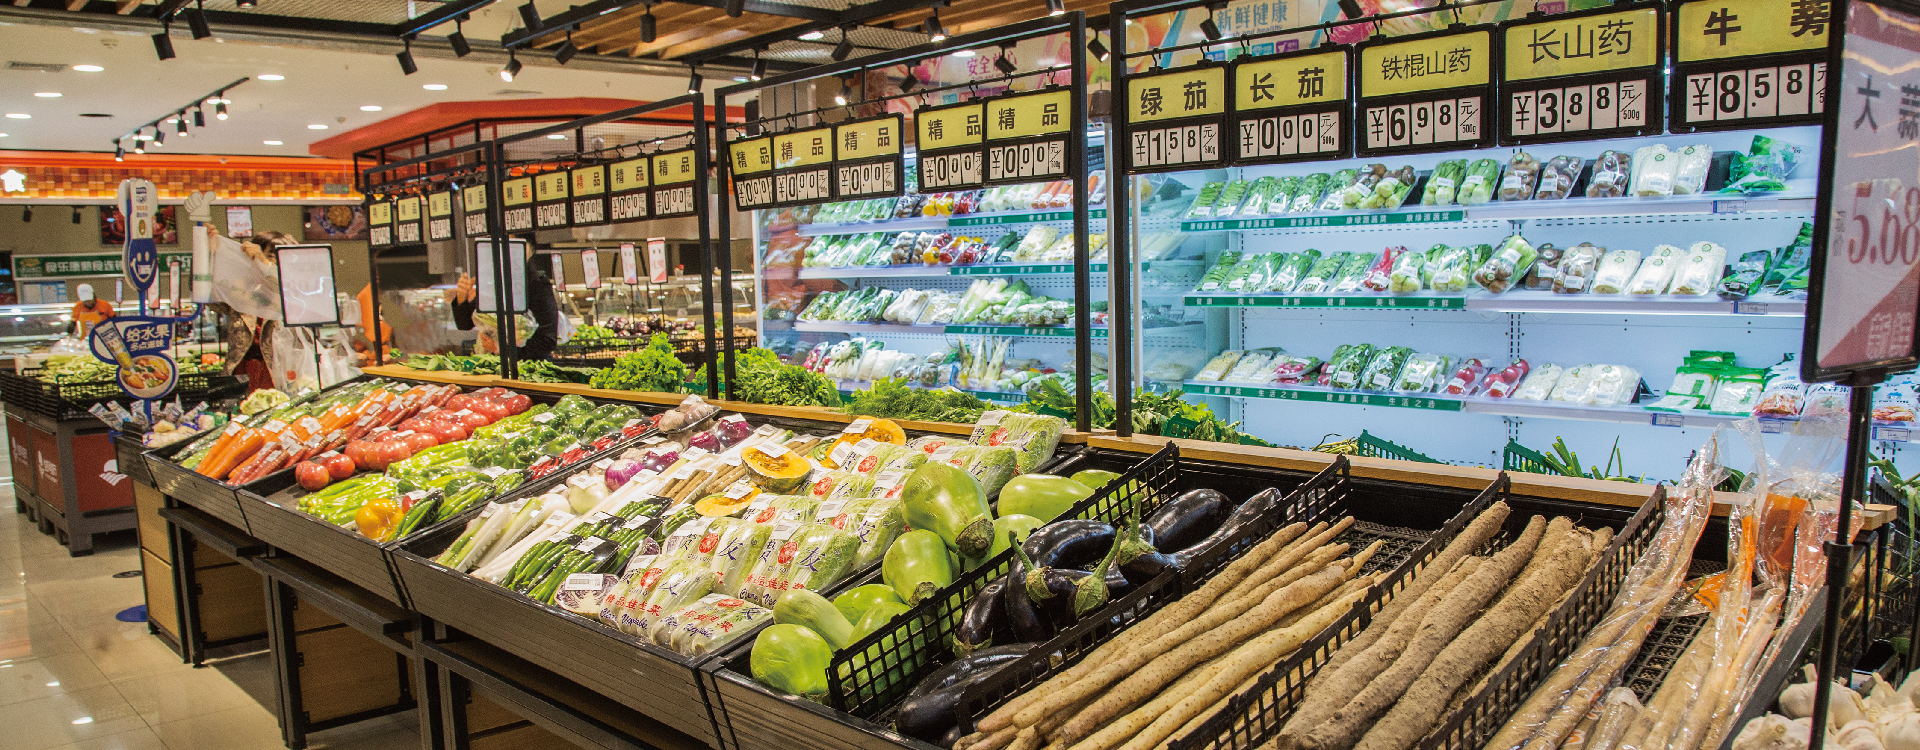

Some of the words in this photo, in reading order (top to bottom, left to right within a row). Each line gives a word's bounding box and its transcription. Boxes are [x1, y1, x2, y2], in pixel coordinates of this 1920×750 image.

[1217, 0, 1288, 32] 新鲜健康
[1528, 19, 1633, 65] 长山药
[967, 51, 1017, 76] 安全心
[1381, 47, 1471, 81] 铁棍山药
[1140, 80, 1207, 116] 绿茄
[1250, 67, 1324, 103] 长茄
[1690, 69, 1803, 116] ¥8.58
[998, 103, 1059, 130] 精品
[1513, 86, 1610, 130] ¥3.88
[928, 114, 981, 141] 精品
[1241, 118, 1313, 153] ¥0.00
[1369, 104, 1451, 141] ¥6.98
[781, 137, 823, 160] 精品
[845, 127, 890, 151] 精品
[1135, 129, 1196, 161] ¥1.58
[658, 156, 690, 177] 精品
[736, 147, 770, 168] 精品
[991, 146, 1045, 175] ¥0.00
[615, 166, 645, 184] 精品
[777, 174, 815, 198] ¥0.00
[841, 166, 881, 192] ¥0.00
[126, 324, 170, 342] 给水果
[1388, 397, 1436, 409] 生活之选
